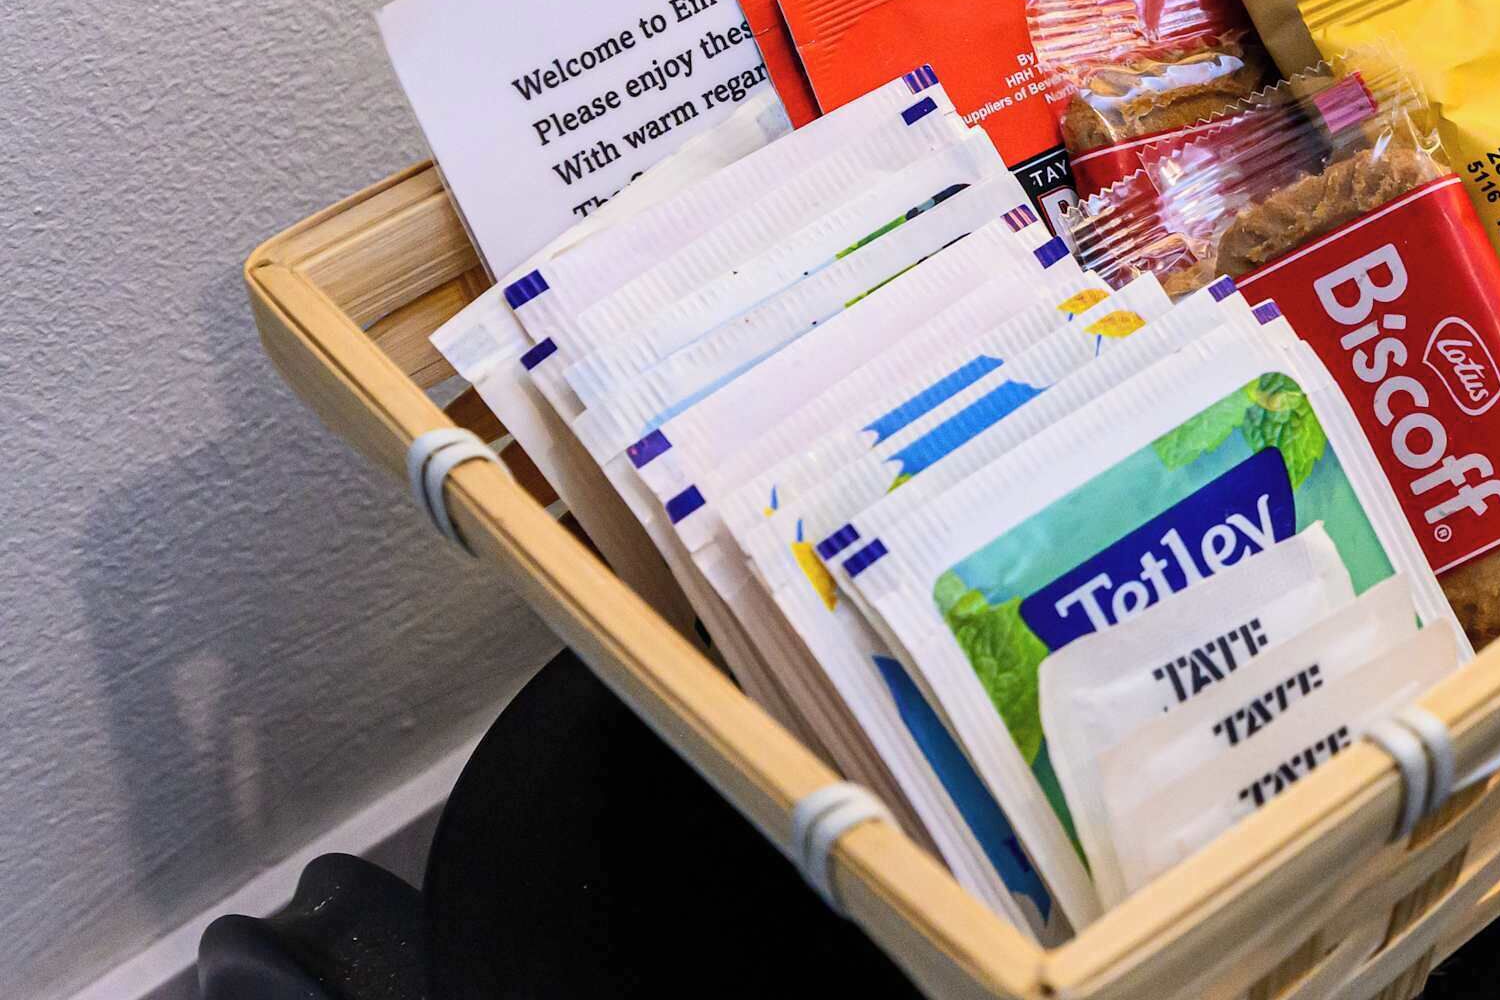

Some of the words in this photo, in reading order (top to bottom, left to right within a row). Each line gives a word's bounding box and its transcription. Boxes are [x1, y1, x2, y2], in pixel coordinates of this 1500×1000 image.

[512, 29, 636, 101] Welcome
[639, 13, 667, 39] to
[532, 90, 622, 146] Please
[625, 49, 693, 98] enjoy
[1005, 67, 1035, 88] HRH
[1014, 87, 1028, 101] of
[1017, 52, 1035, 66] By
[552, 141, 622, 186] With
[623, 100, 699, 149] warm
[1436, 339, 1489, 402] Lotus
[1055, 494, 1276, 631] Tetley
[1152, 618, 1268, 703] TATE
[1212, 664, 1324, 746] TATE
